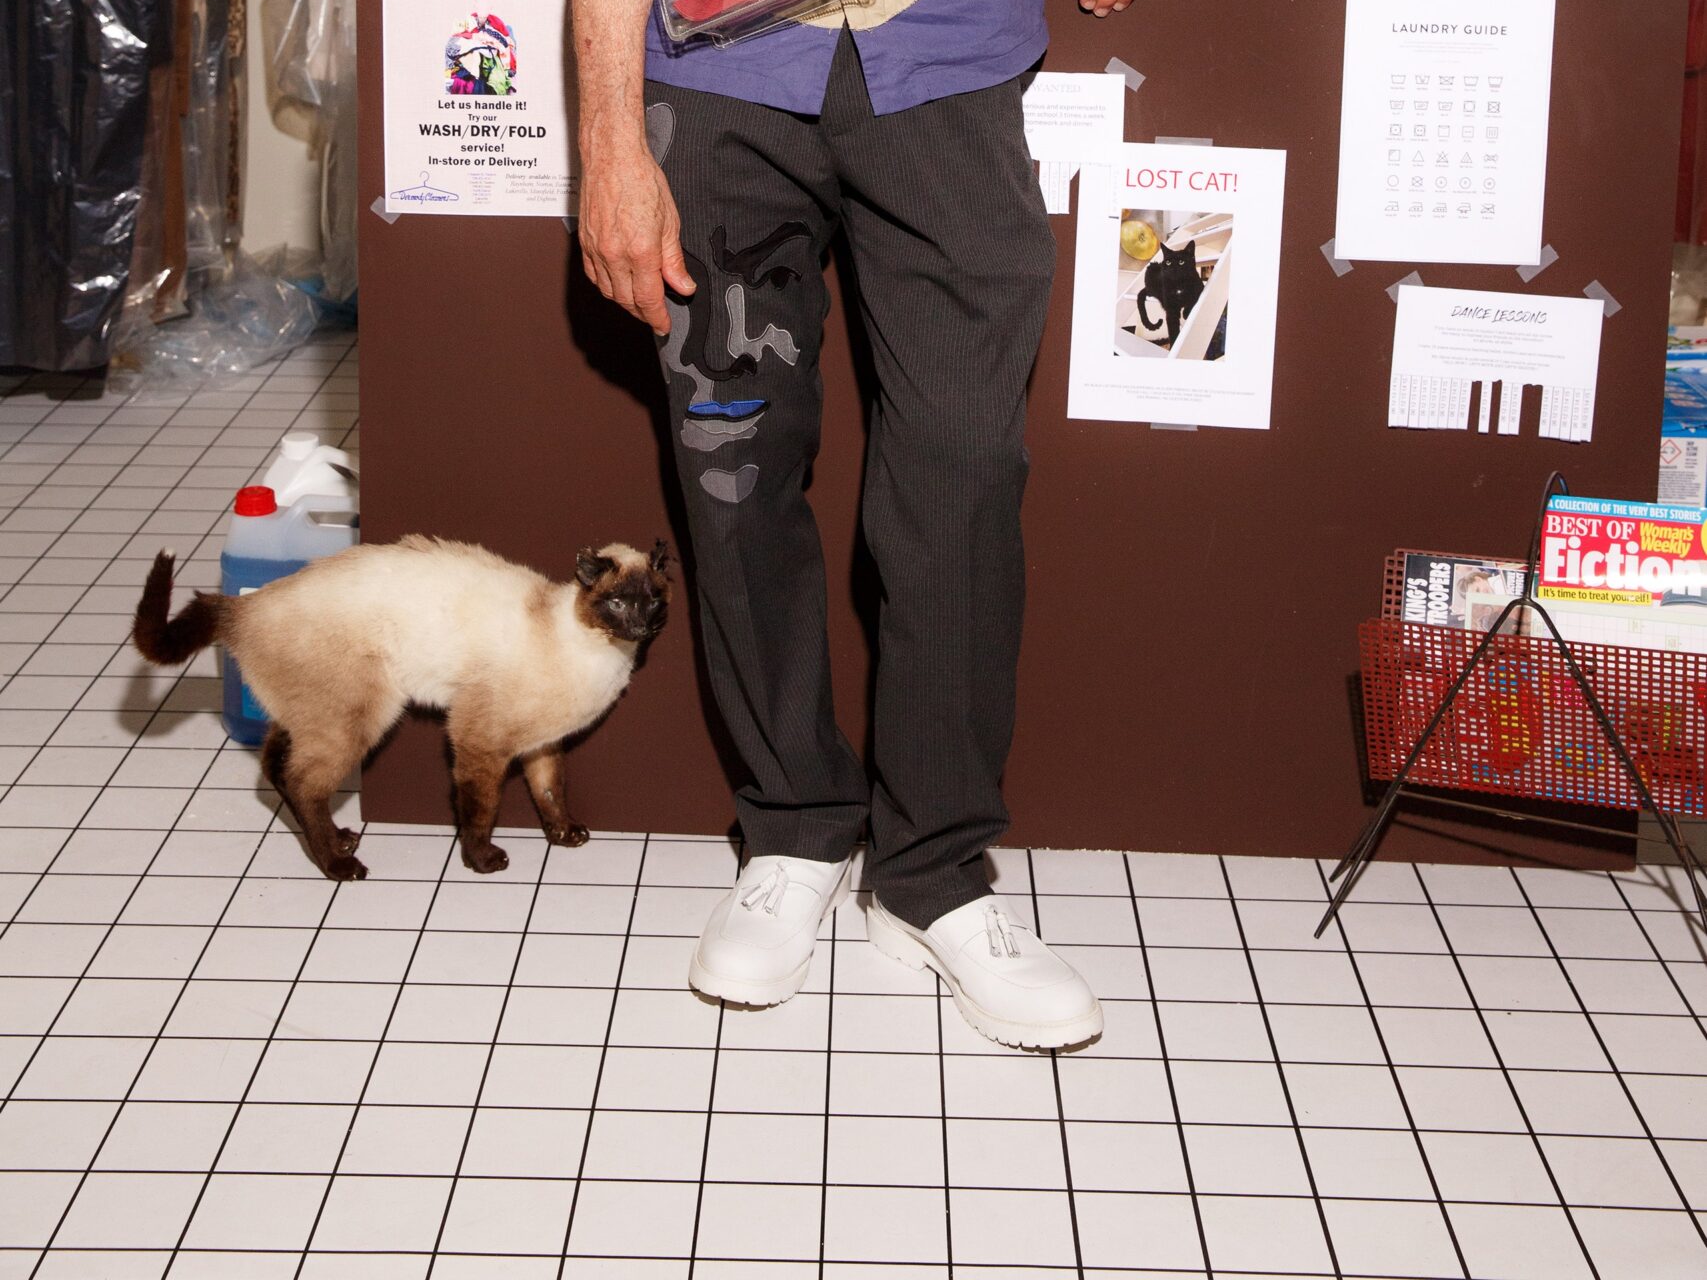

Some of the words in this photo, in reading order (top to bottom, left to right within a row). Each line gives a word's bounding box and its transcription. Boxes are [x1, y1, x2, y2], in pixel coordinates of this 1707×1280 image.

[1392, 23, 1458, 35] LAUNDRY
[1464, 24, 1508, 36] GUIDE
[438, 100, 455, 109] Let
[458, 102, 471, 110] us
[474, 100, 512, 110] handle
[515, 101, 527, 111] it!
[467, 114, 480, 123] Try
[419, 123, 546, 140] WASH/DRY/FOLD
[460, 143, 504, 153] service!
[428, 156, 470, 166] In-store
[488, 157, 537, 169] Delivery!
[1125, 168, 1183, 189] LOST
[1189, 171, 1238, 193] CAT!
[1451, 305, 1492, 320] DANCE
[1491, 309, 1548, 324] LESSONS
[1555, 499, 1600, 513] COLLECTION
[1601, 503, 1612, 513] OF
[1612, 503, 1627, 515] THE
[1628, 505, 1648, 518] VERY
[1649, 507, 1669, 519] BEST
[1669, 509, 1702, 522] STORIES
[1546, 515, 1602, 538] BEST
[1606, 520, 1636, 540] OF
[1640, 521, 1694, 541] Woman's
[1640, 536, 1691, 558] Weekly
[1544, 536, 1702, 597] Fiction
[1404, 577, 1428, 623] KING'S
[1426, 562, 1451, 627] TROOPERS
[1543, 588, 1555, 598] It's
[1557, 589, 1576, 600] time
[1578, 591, 1587, 600] to
[1589, 591, 1609, 602] treat
